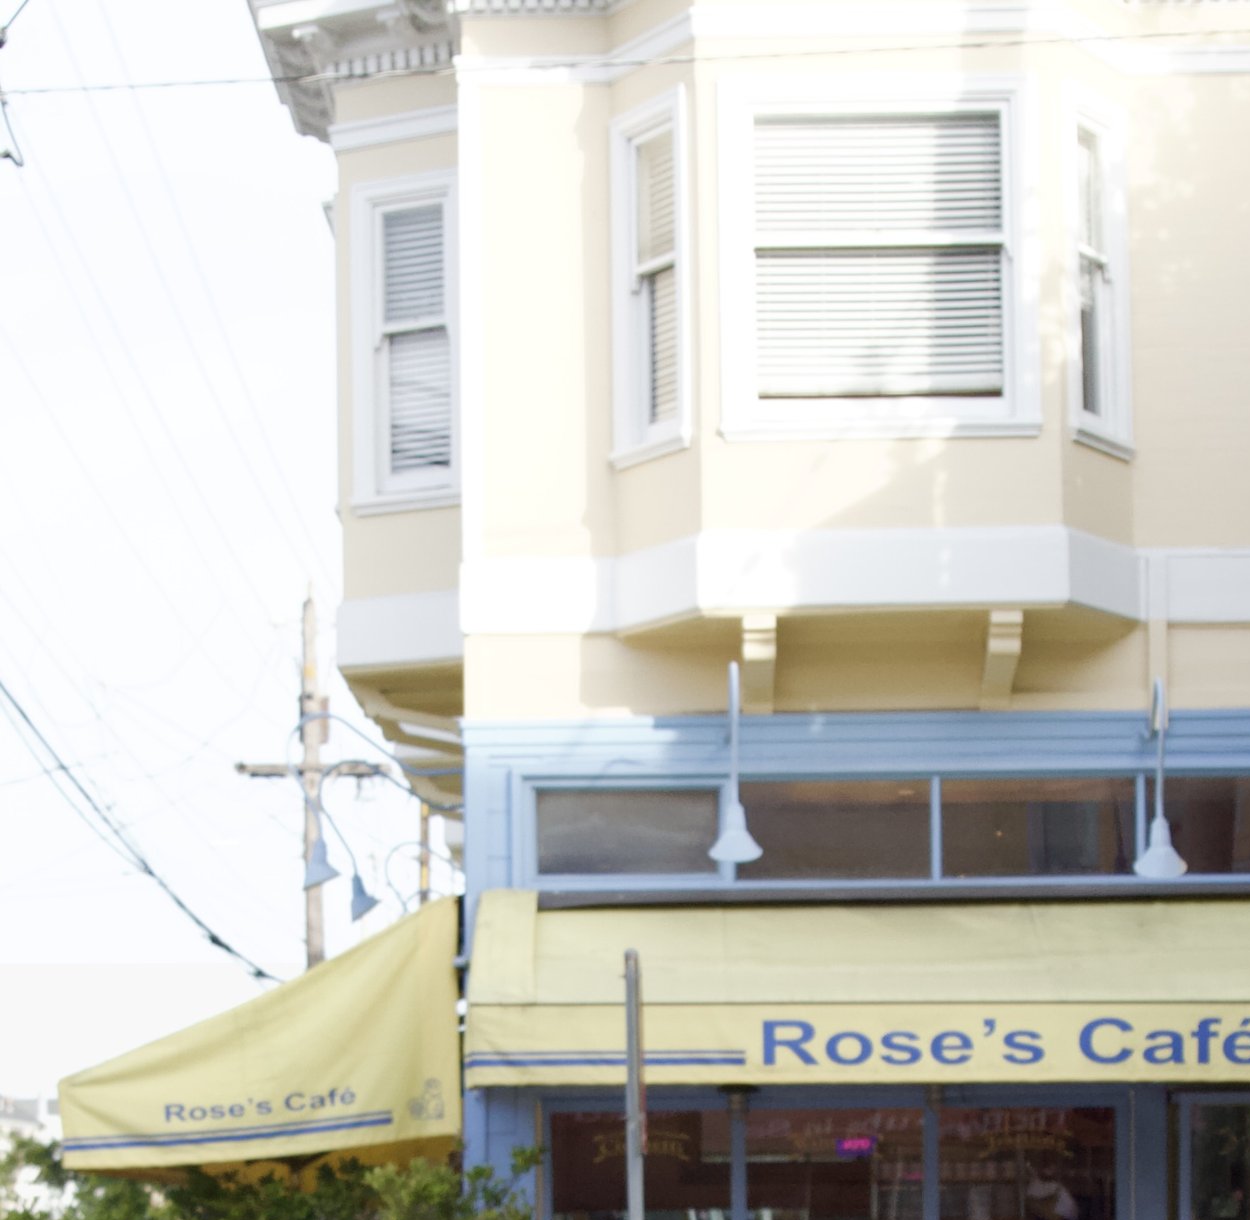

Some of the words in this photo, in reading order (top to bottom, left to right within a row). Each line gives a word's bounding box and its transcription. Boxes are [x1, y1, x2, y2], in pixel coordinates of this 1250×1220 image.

[761, 1018, 1045, 1066] Rose's
[164, 1098, 273, 1123] Rose's
[284, 1087, 357, 1112] Café
